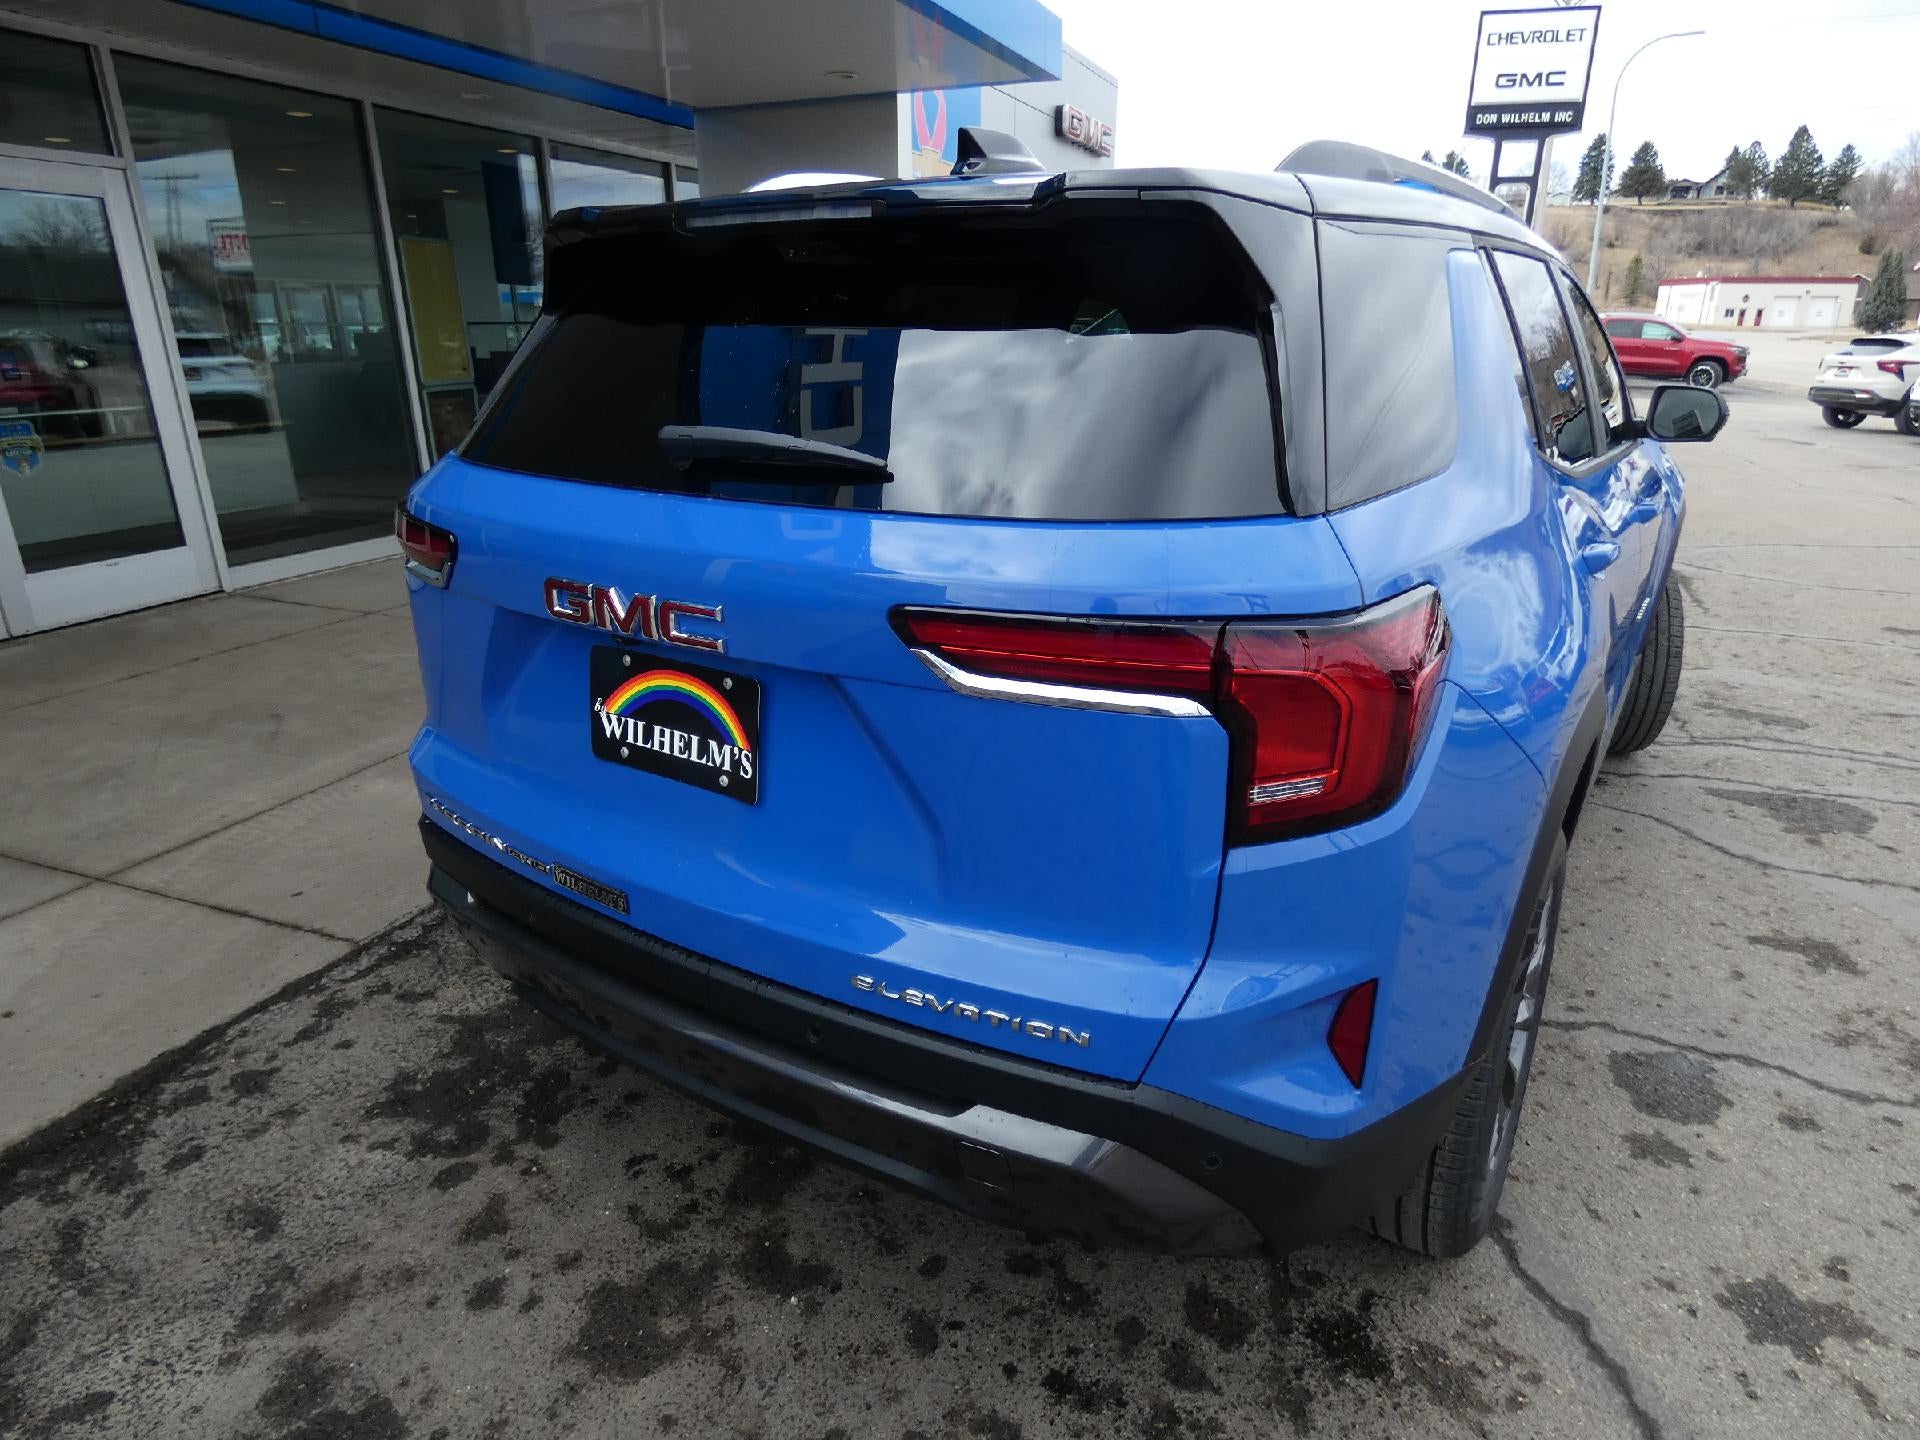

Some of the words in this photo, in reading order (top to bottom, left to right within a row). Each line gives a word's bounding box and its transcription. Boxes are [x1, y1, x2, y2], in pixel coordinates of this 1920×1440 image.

[1486, 27, 1588, 46] CHEVROLET
[1494, 70, 1567, 88] GMC
[1059, 103, 1113, 157] GMC
[1475, 113, 1498, 125] DON
[1501, 111, 1551, 124] WILHELM
[1554, 110, 1574, 123] INC
[543, 575, 728, 654] GMC
[600, 710, 754, 780] WILHELM'S
[851, 974, 1092, 1049] ELEVATION
